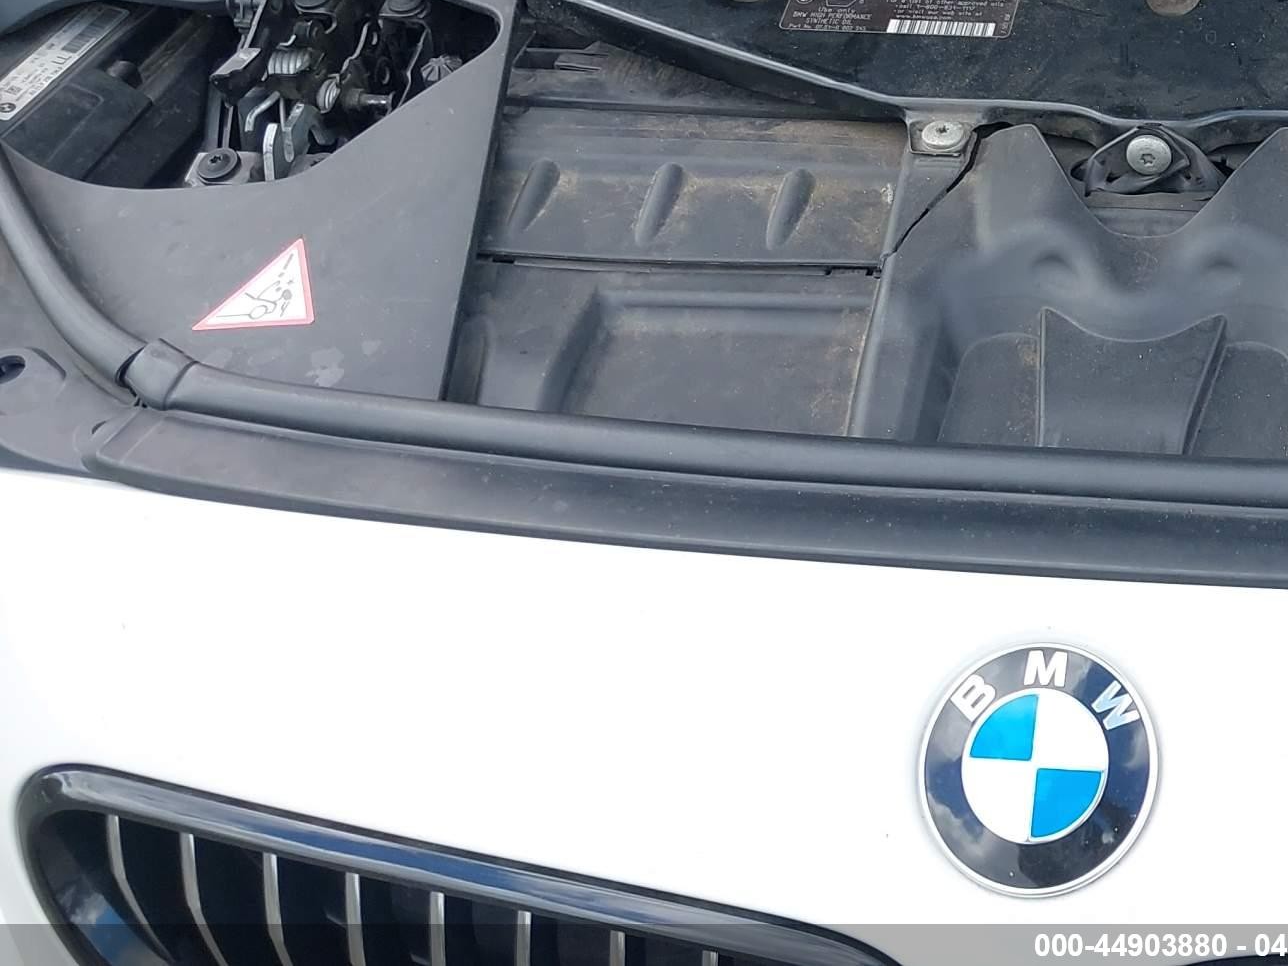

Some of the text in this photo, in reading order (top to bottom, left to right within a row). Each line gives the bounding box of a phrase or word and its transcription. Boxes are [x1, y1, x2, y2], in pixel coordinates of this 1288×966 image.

[793, 10, 873, 21] BMW HIGH PERFORMANCE
[837, 6, 856, 14] only
[950, 649, 1141, 732] BMW
